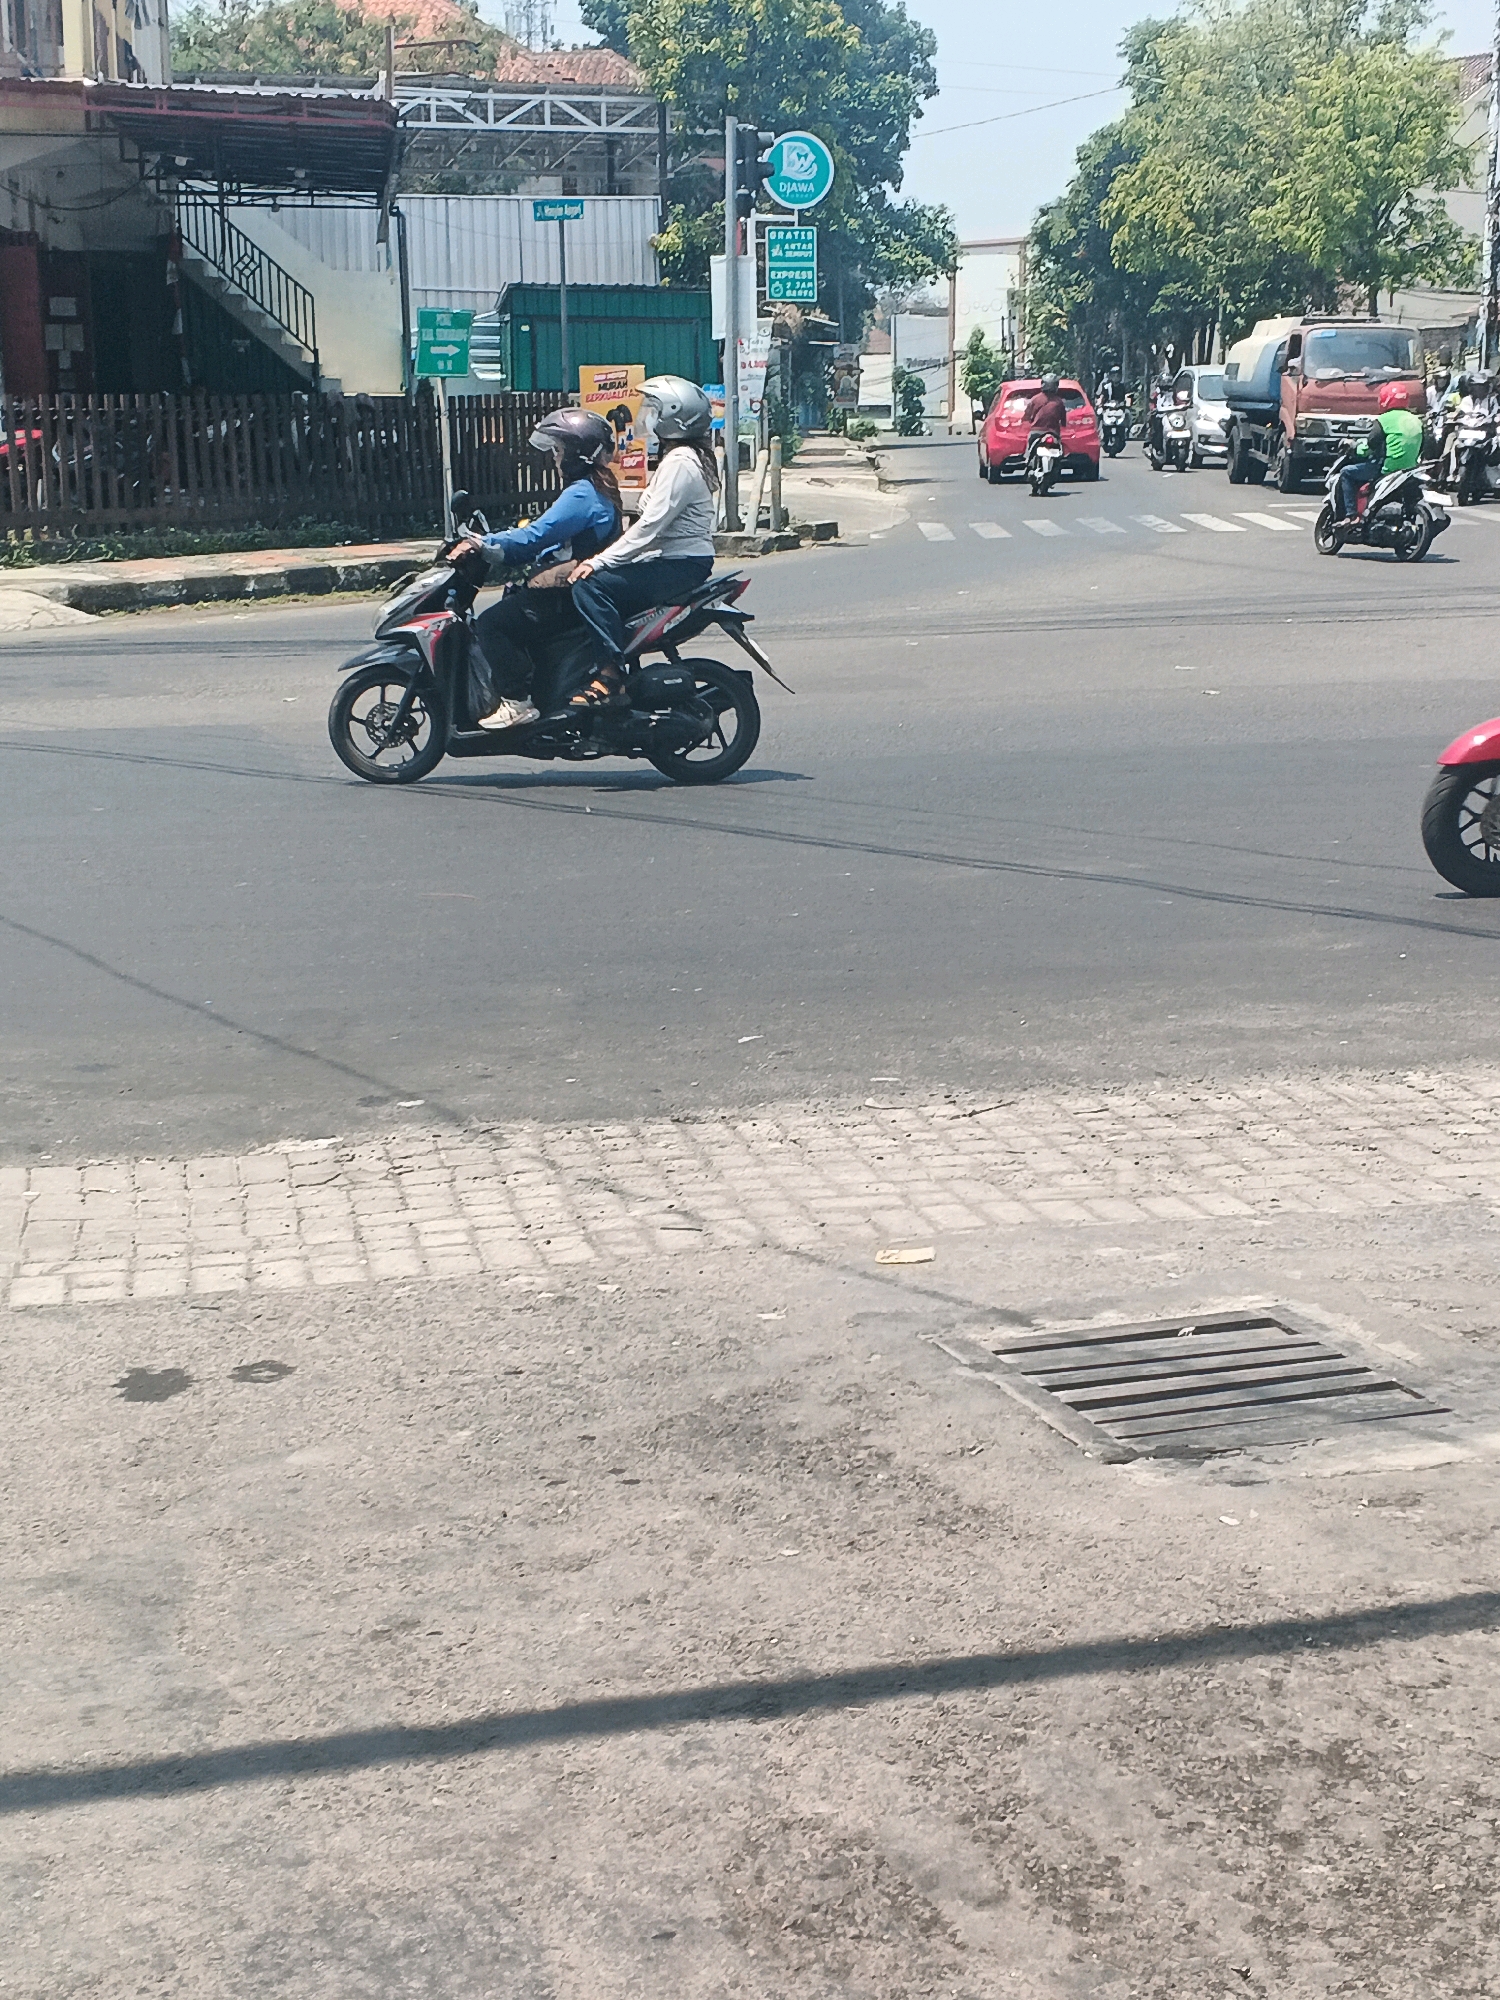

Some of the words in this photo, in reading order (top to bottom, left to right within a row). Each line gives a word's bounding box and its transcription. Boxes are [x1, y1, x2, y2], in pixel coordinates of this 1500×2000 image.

[779, 182, 815, 197] DJAWA
[769, 231, 813, 240] GRATIS
[770, 270, 813, 280] EXPRESS
[598, 380, 628, 392] MURAH
